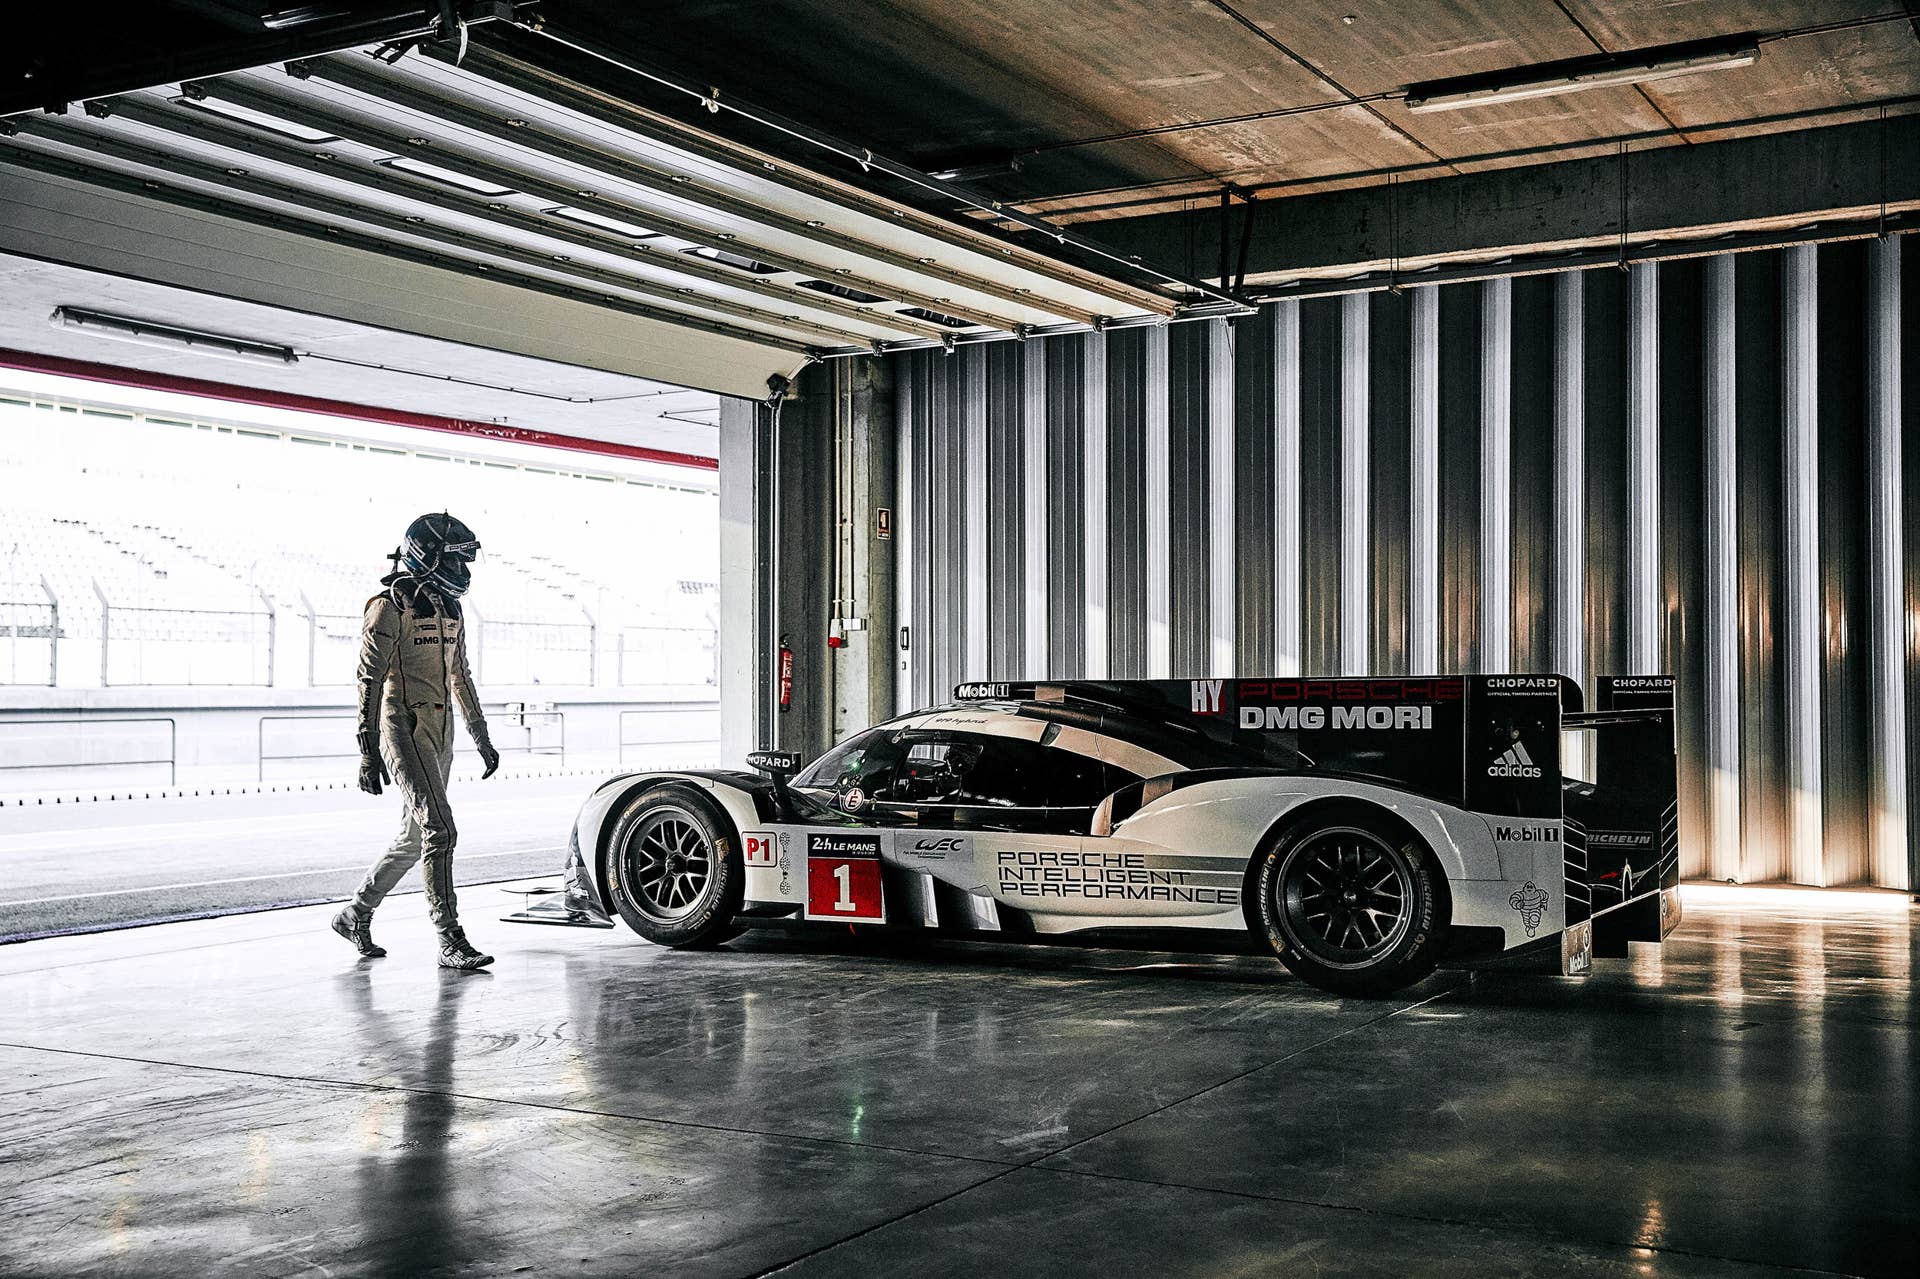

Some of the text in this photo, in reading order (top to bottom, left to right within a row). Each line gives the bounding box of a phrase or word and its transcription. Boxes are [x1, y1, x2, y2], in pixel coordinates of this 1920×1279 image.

[414, 637, 439, 645] DMG
[958, 684, 996, 698] Mobil
[1239, 681, 1464, 700] PORSCHE
[1487, 678, 1557, 688] CHOPARD
[1612, 679, 1672, 687] CHOPARD
[1191, 680, 1224, 713] HY
[1239, 706, 1433, 730] DMG MORI
[1487, 763, 1542, 778] adidas
[1496, 827, 1542, 842] Mobil
[746, 837, 770, 861] P1
[833, 843, 846, 851] LE
[846, 843, 876, 852] MANS
[915, 837, 965, 852] WEC
[997, 851, 1145, 869] PORSCHE
[998, 866, 1191, 886] INTELLIGENT
[833, 864, 856, 912] 1
[999, 882, 1239, 905] PERFORMANCE
[1258, 867, 1271, 926] MICHELIN
[1420, 870, 1433, 930] MICHELIN
